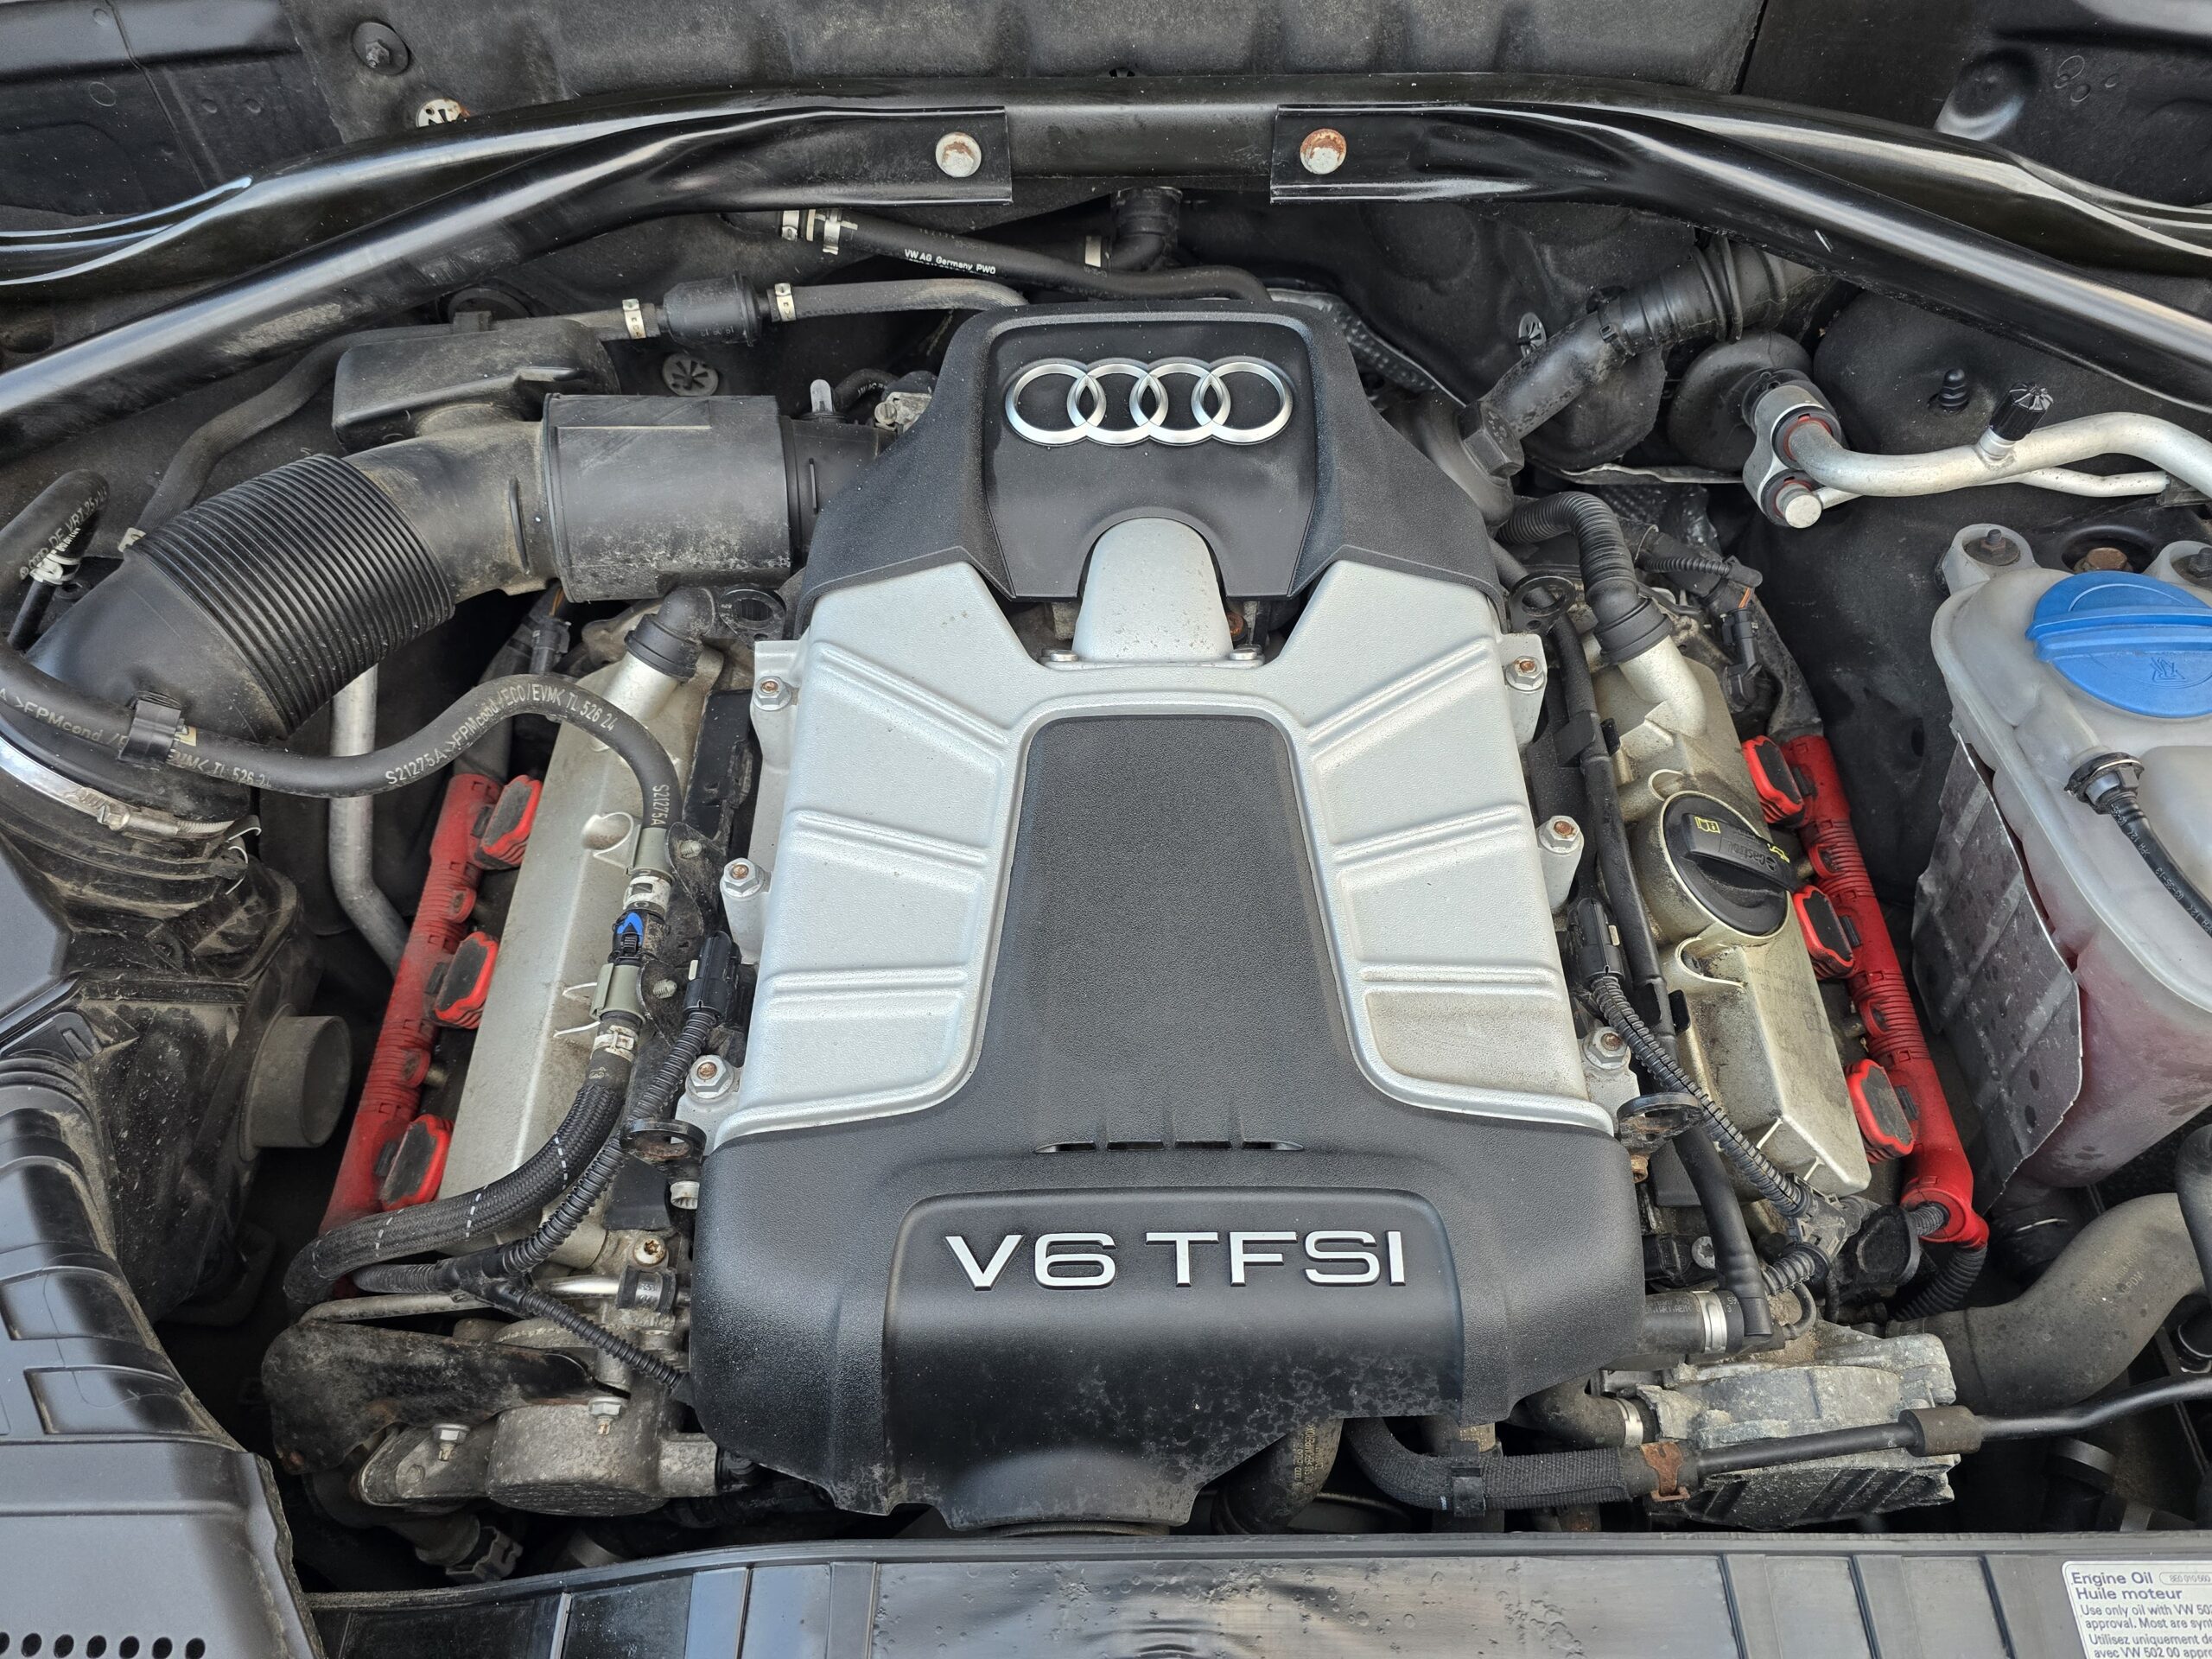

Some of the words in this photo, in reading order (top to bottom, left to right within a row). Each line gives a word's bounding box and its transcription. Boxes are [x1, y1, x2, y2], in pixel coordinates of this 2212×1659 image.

[904, 248, 918, 259] VW
[919, 252, 932, 262] AG
[936, 256, 973, 270] Germany
[385, 747, 448, 784] S21275A
[566, 691, 579, 711] TL
[580, 700, 603, 722] 526
[601, 713, 618, 732] 24
[232, 766, 255, 785] 526
[651, 784, 671, 826] S21275A
[944, 1232, 1117, 1291] V6
[1145, 1230, 1407, 1287] TFSI
[2071, 1572, 2126, 1587] Engine
[2131, 1571, 2154, 1584] Oil
[2075, 1587, 2117, 1599] Huile
[2121, 1588, 2183, 1599] moteur
[2080, 1605, 2102, 1615] Use
[2105, 1605, 2128, 1618] only
[2132, 1605, 2145, 1615] oil
[2148, 1605, 2172, 1615] with
[2174, 1605, 2194, 1615] VW
[2085, 1618, 2137, 1630] approval.
[2139, 1618, 2168, 1629] Most
[2171, 1620, 2188, 1629] are
[2088, 1634, 2129, 1644] Utilisez
[2132, 1634, 2200, 1647] uniquement
[2094, 1649, 2120, 1658] avec
[2120, 1648, 2141, 1658] VW
[2144, 1648, 2164, 1658] 502
[2166, 1648, 2180, 1658] 00
